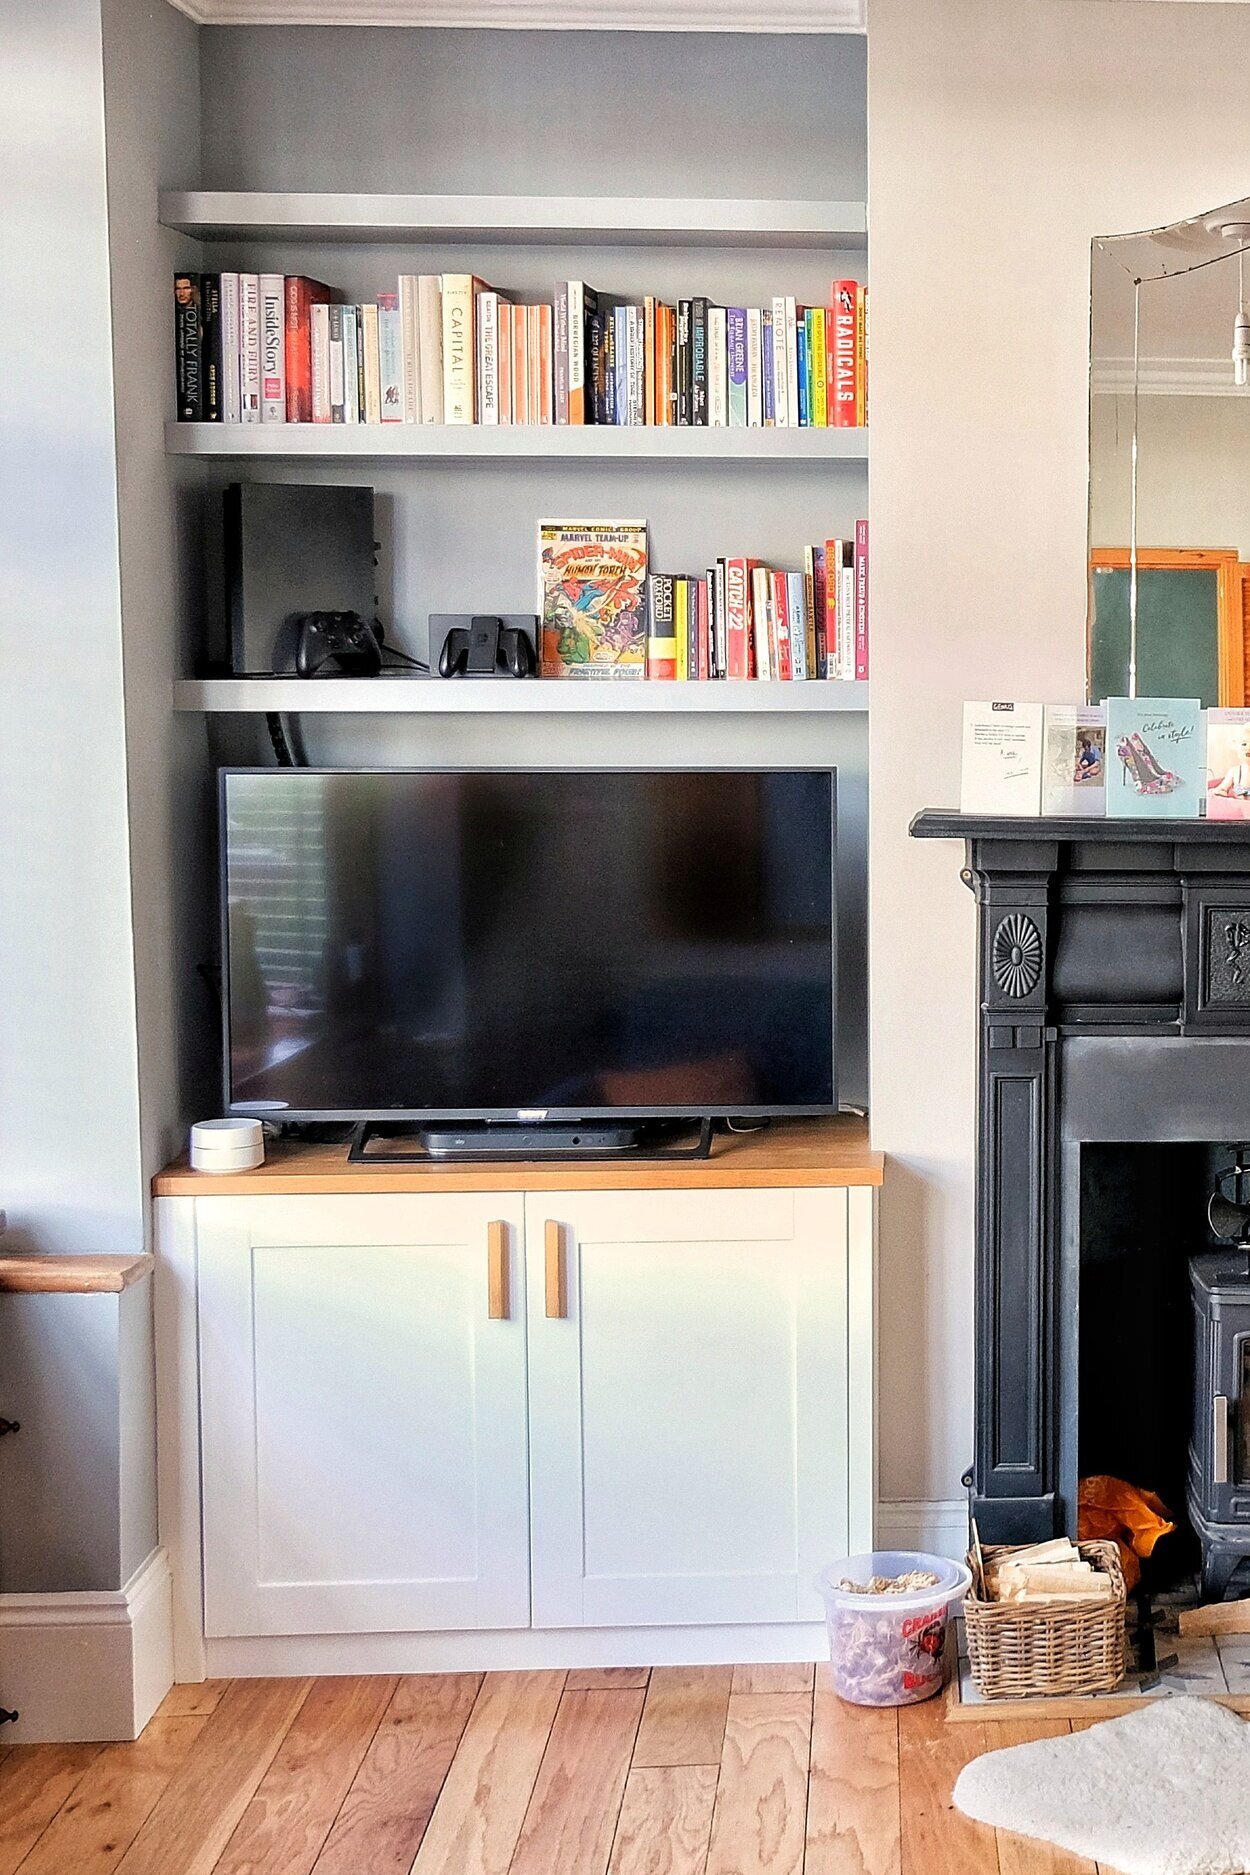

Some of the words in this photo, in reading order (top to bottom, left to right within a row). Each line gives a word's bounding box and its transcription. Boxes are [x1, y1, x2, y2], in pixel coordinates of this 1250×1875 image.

[247, 283, 257, 313] FIRE
[186, 304, 198, 357] TOTALLY
[248, 318, 257, 347] AND
[452, 307, 463, 373] CAPITAL
[485, 326, 493, 343] THE
[735, 317, 744, 341] BRIAN
[775, 303, 784, 351] REMOTE
[248, 351, 258, 384] FURY
[485, 343, 493, 372] GREAT
[696, 327, 704, 381] IMPROBABLE
[736, 342, 745, 373] GREENE
[837, 315, 854, 401] RADICALS
[187, 361, 198, 403] FRANK
[485, 374, 494, 408] ESCAPE
[560, 534, 593, 543] MARVEL
[596, 534, 629, 543] TEAM-UP
[555, 544, 637, 574] SPIDER-MAN
[563, 564, 596, 576] HUMAN
[599, 565, 627, 576] TORCH
[656, 578, 664, 619] OXFORD
[663, 578, 672, 619] POCKET
[729, 567, 744, 631] CATCH-22
[1142, 721, 1175, 734] Celebrate
